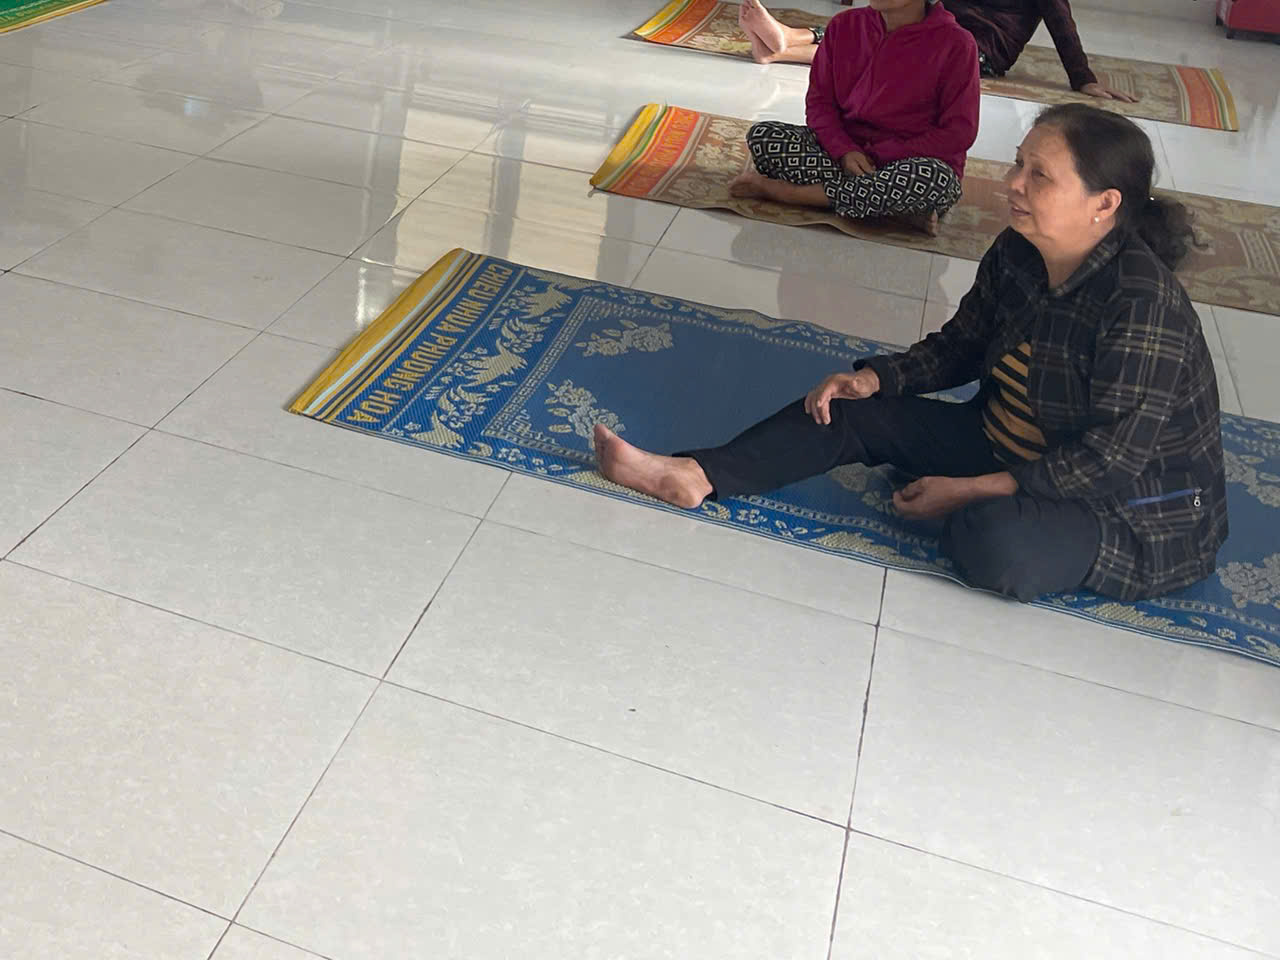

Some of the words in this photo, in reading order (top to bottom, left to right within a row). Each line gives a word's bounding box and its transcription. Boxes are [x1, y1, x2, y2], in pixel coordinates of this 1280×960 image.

[470, 263, 513, 301] CHIEU
[435, 297, 488, 333] NHUA
[383, 332, 458, 391] PHUONG
[346, 389, 402, 422] HOA
